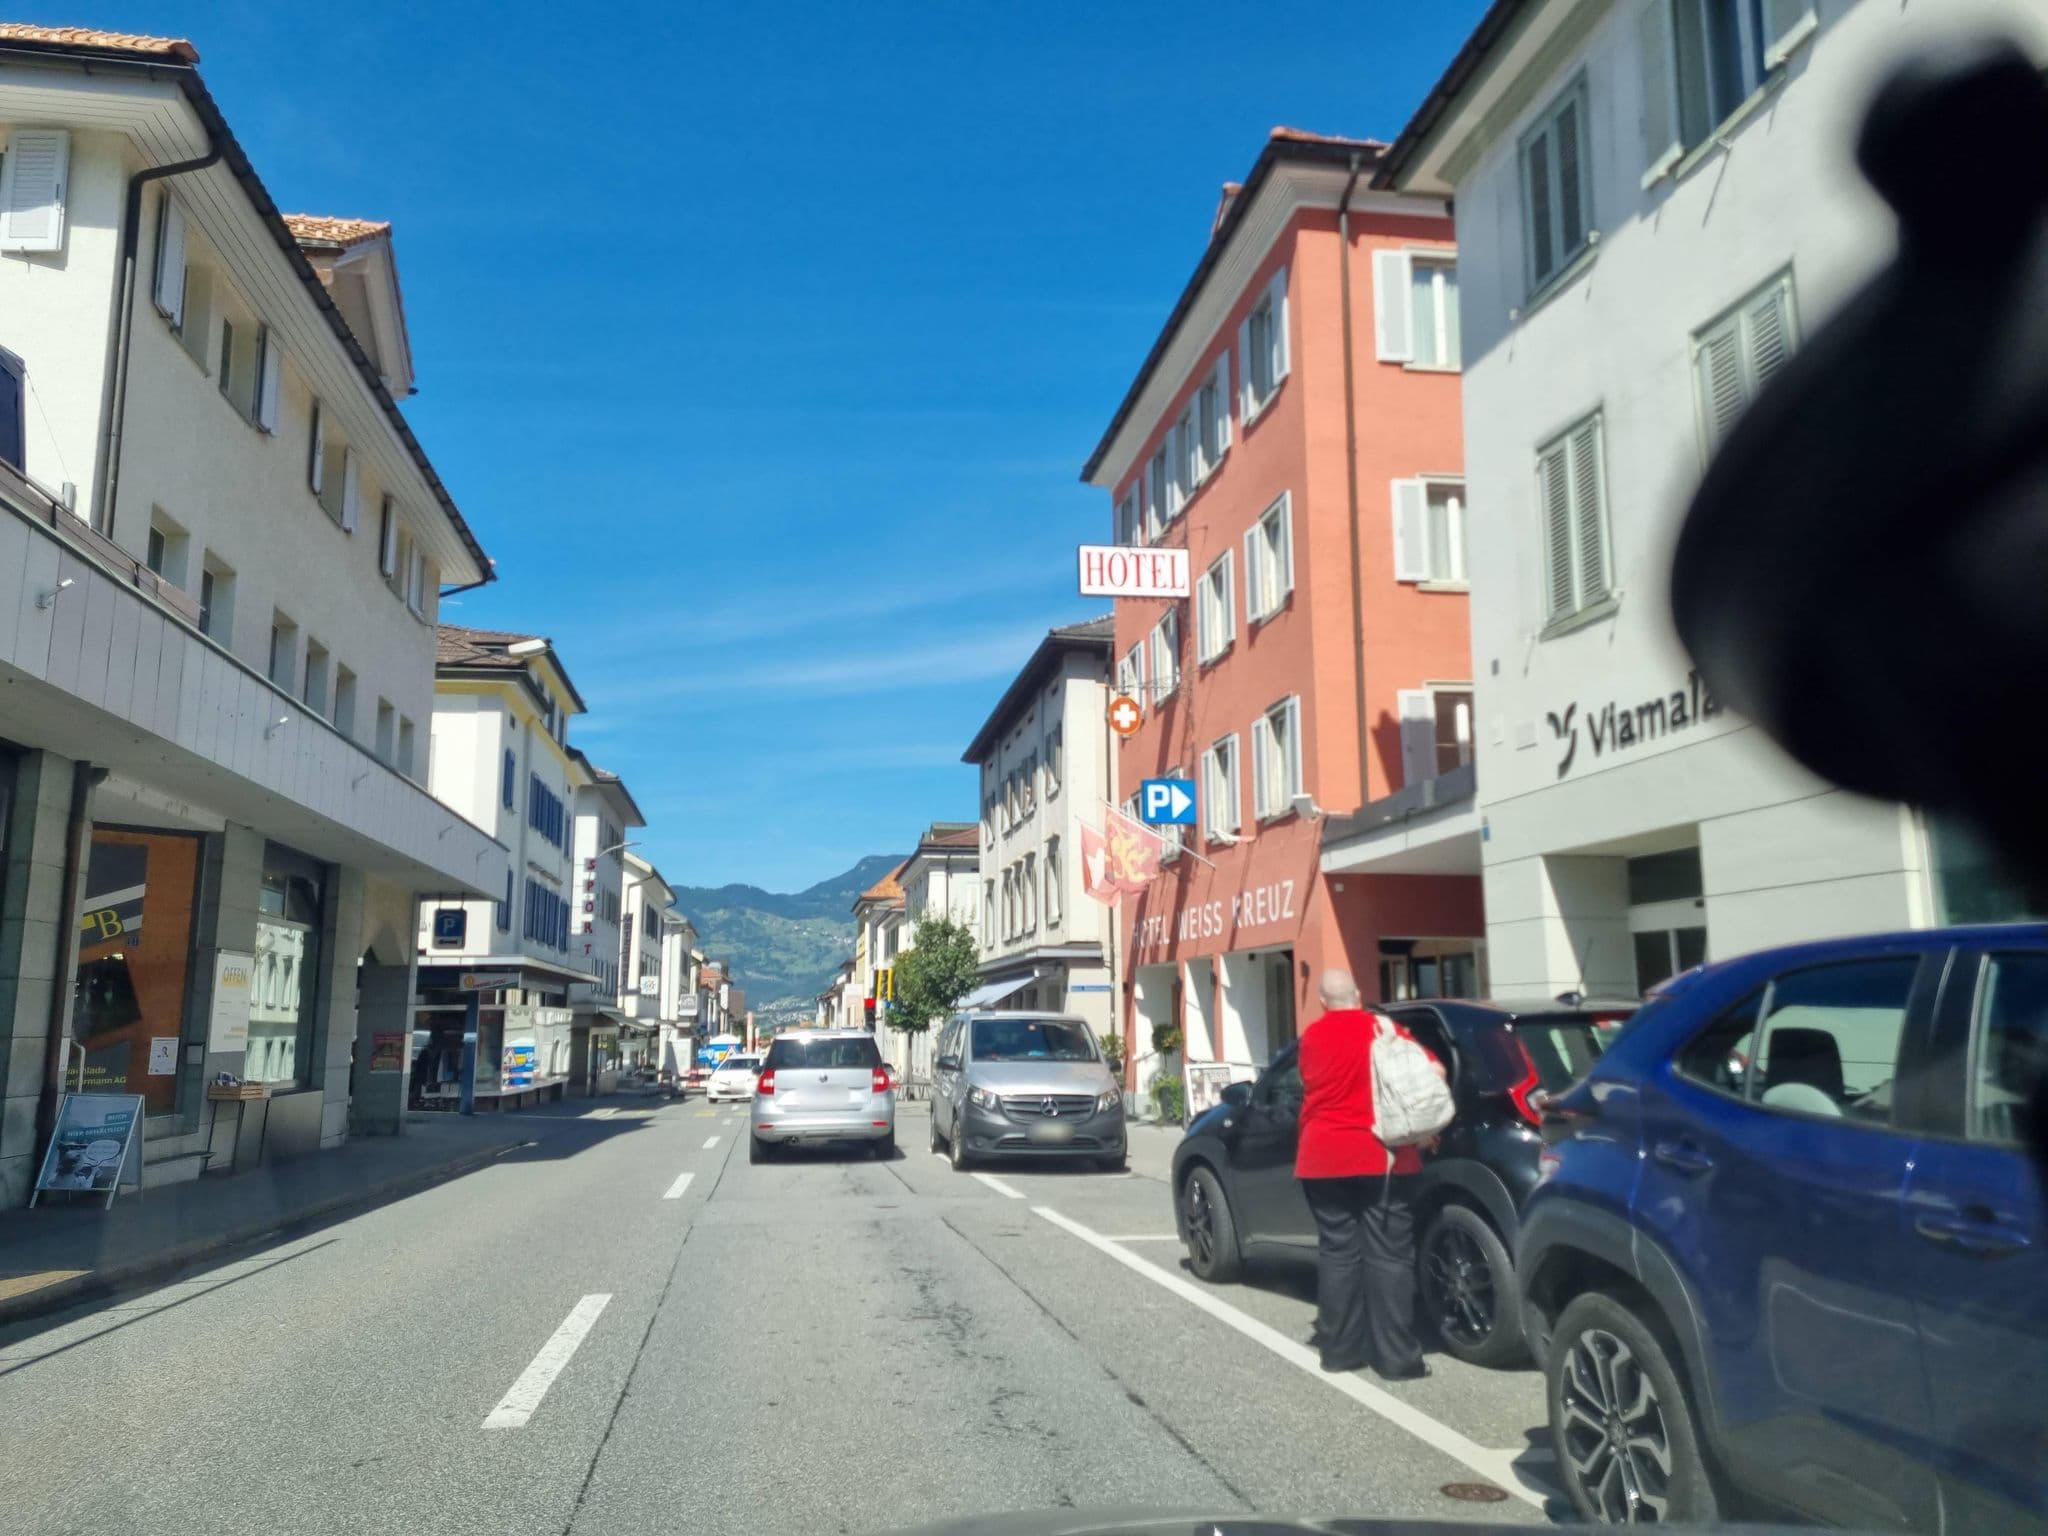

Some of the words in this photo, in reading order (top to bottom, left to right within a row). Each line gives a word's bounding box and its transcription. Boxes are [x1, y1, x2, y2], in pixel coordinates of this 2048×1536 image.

[1086, 552, 1185, 588] HOTEL
[1147, 784, 1170, 818] P
[584, 859, 596, 956] SPORT
[1178, 901, 1223, 941] WEISS
[1232, 880, 1294, 929] KREUZ
[443, 918, 456, 934] P
